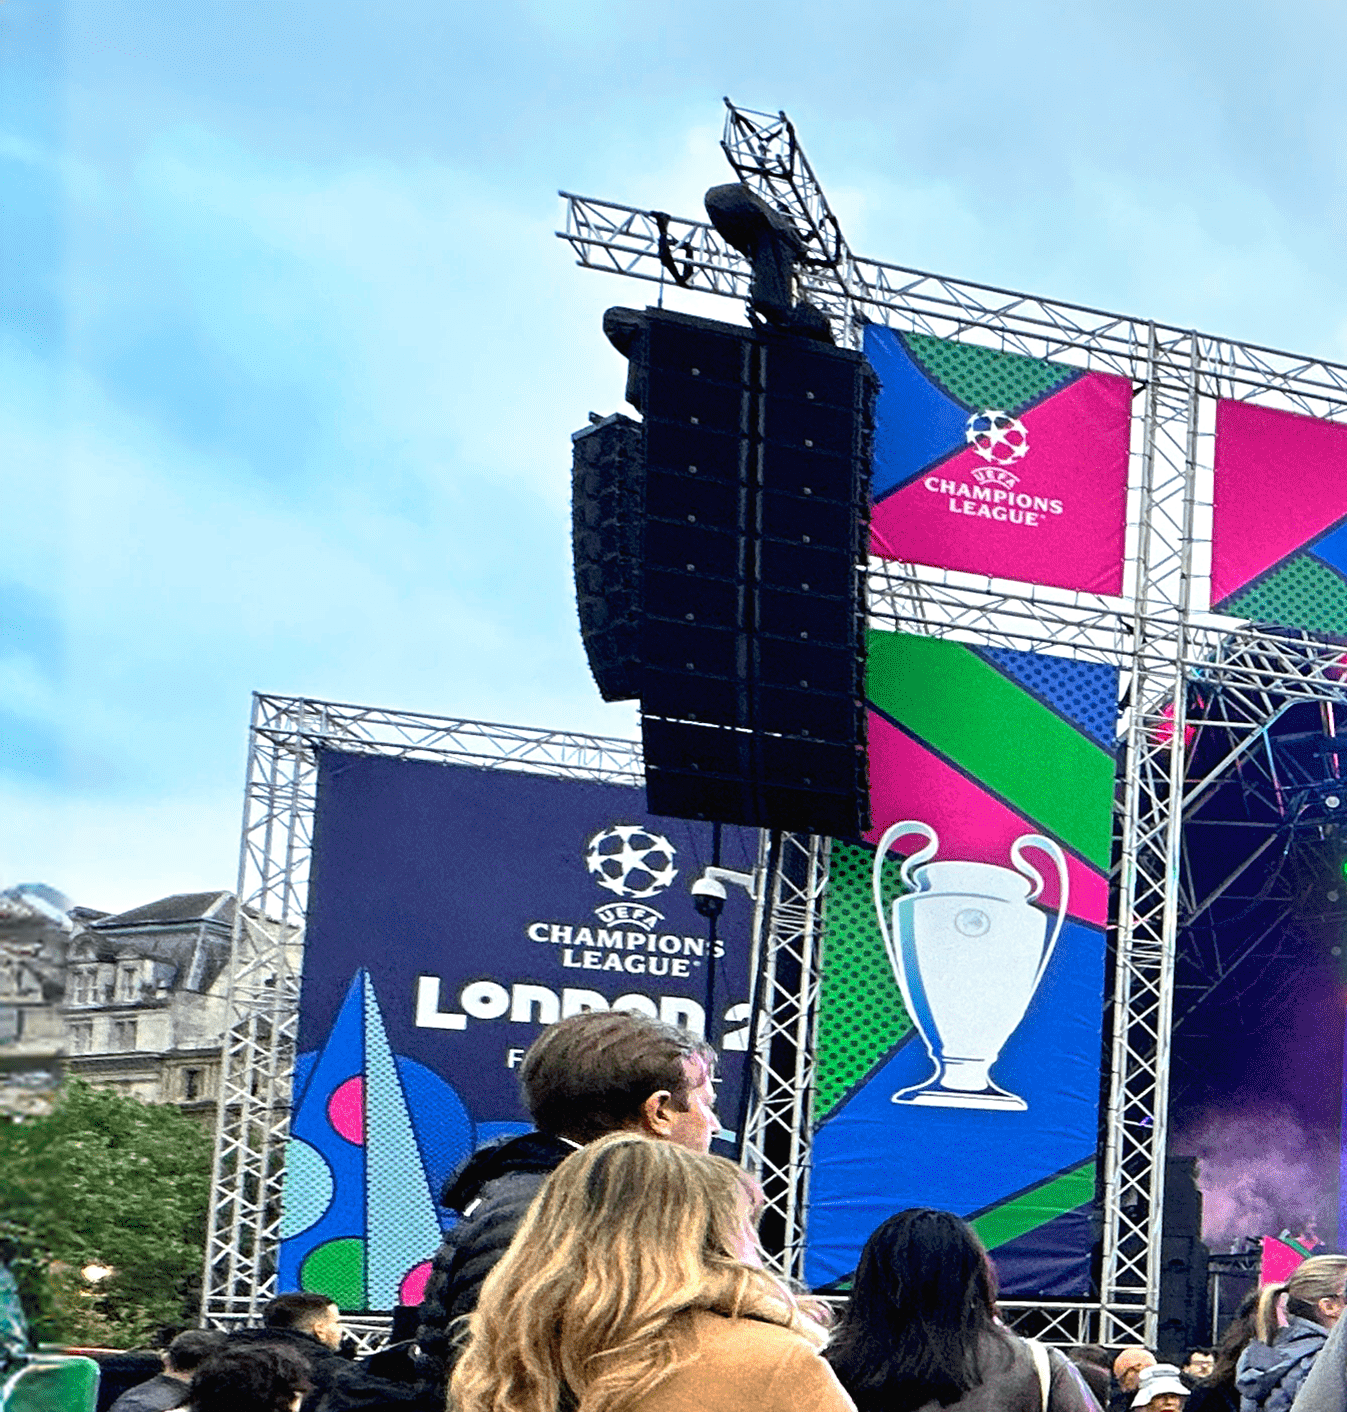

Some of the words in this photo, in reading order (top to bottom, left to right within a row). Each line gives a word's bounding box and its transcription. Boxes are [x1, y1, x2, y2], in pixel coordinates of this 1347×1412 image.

[972, 469, 1016, 490] UEFA
[924, 477, 1064, 515] CHAMPIONS
[948, 498, 1039, 527] LEAGUE
[599, 906, 658, 928] UEFA
[528, 922, 726, 959] CHAMPIONS
[562, 949, 690, 977] LEAGUE
